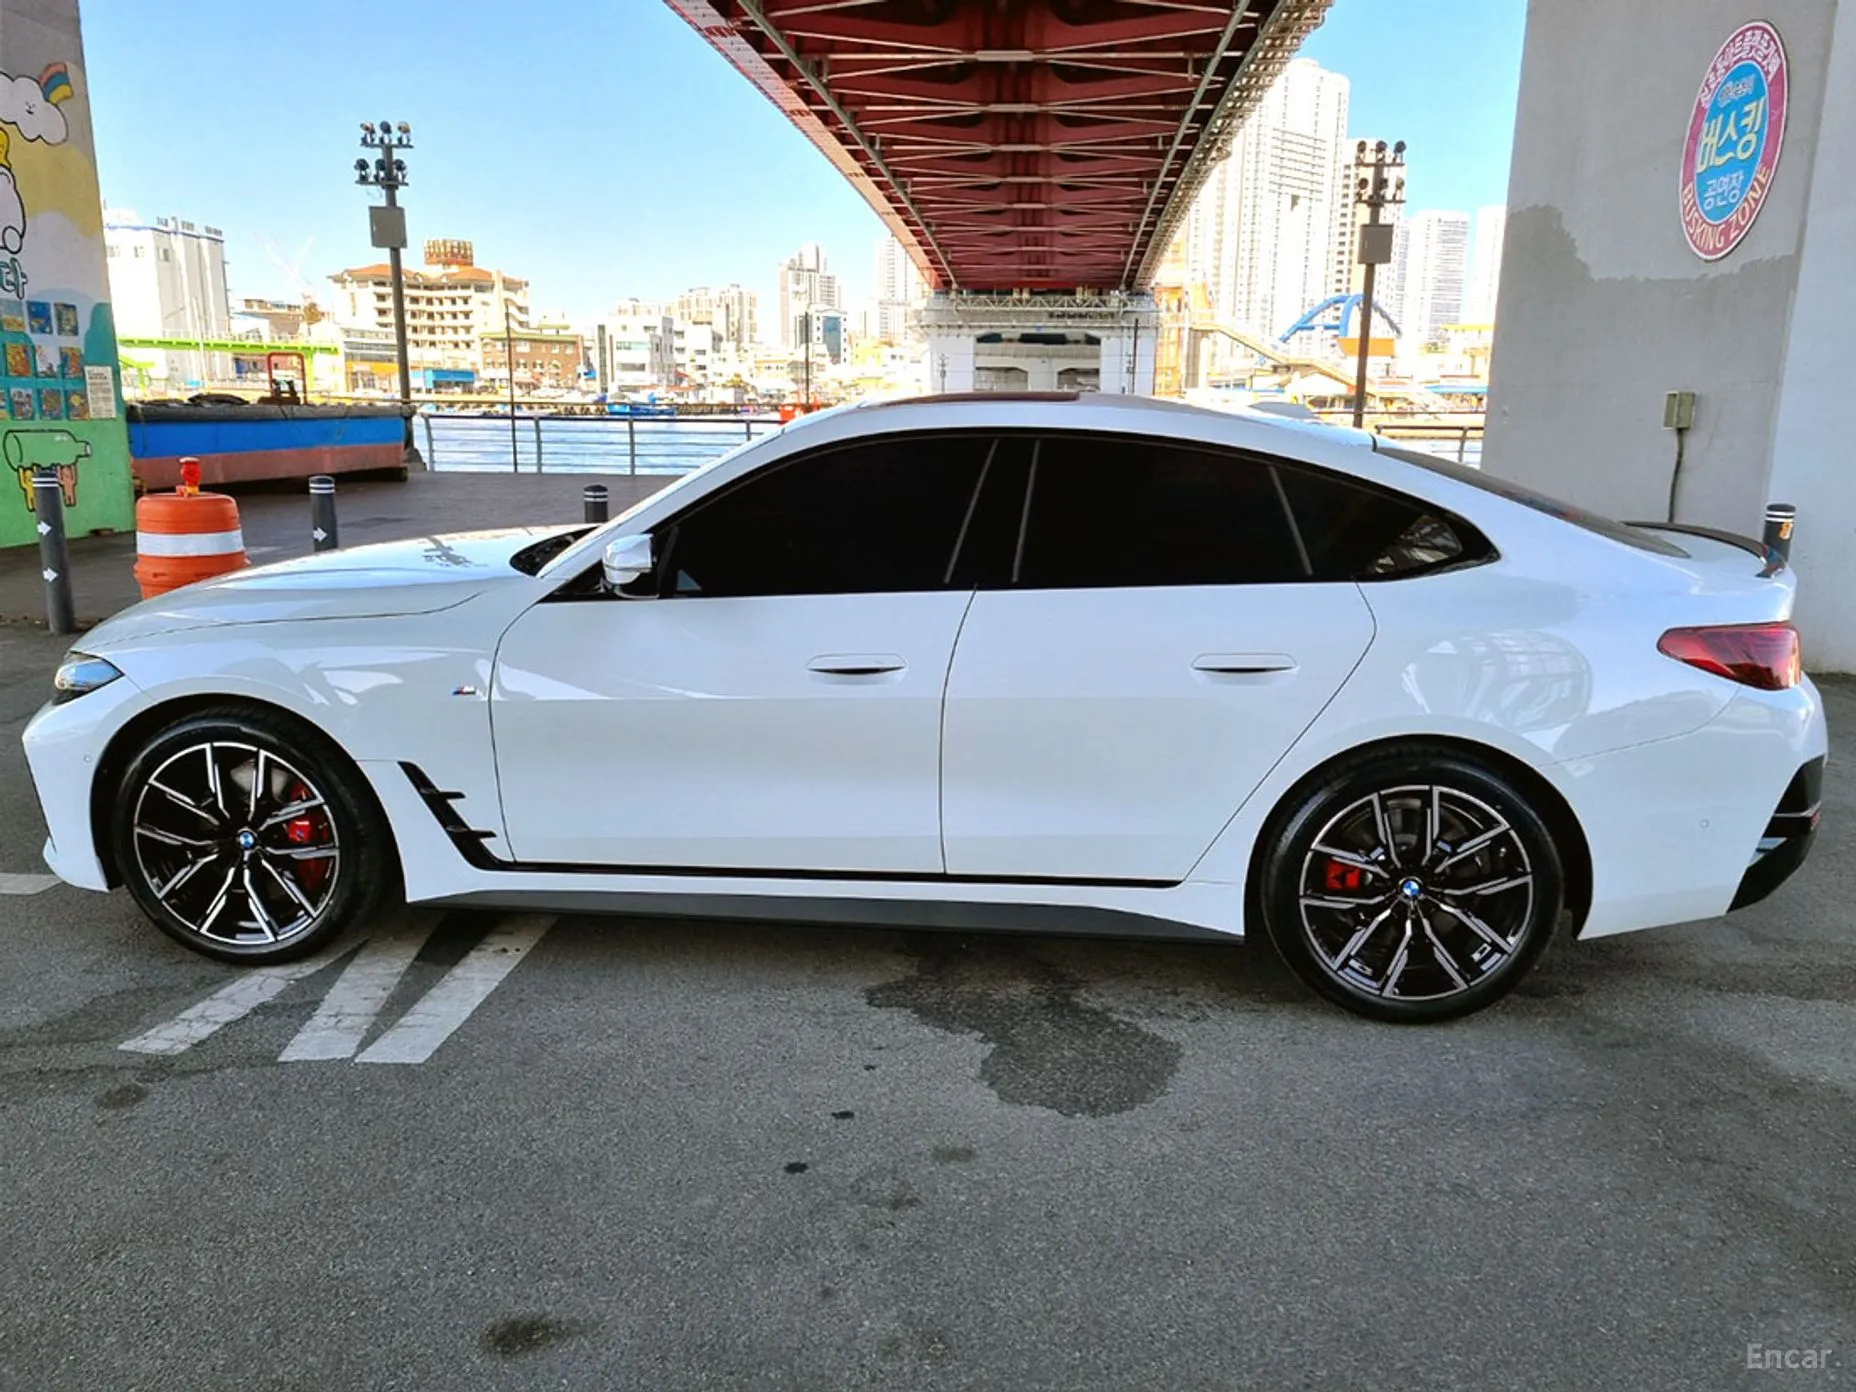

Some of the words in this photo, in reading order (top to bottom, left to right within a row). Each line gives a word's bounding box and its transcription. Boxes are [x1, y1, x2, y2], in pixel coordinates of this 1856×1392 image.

[1696, 97, 1767, 173] 버스킹
[1683, 182, 1726, 250] BUSKING
[1729, 163, 1770, 240] ZONE
[1703, 169, 1744, 211] 공연장
